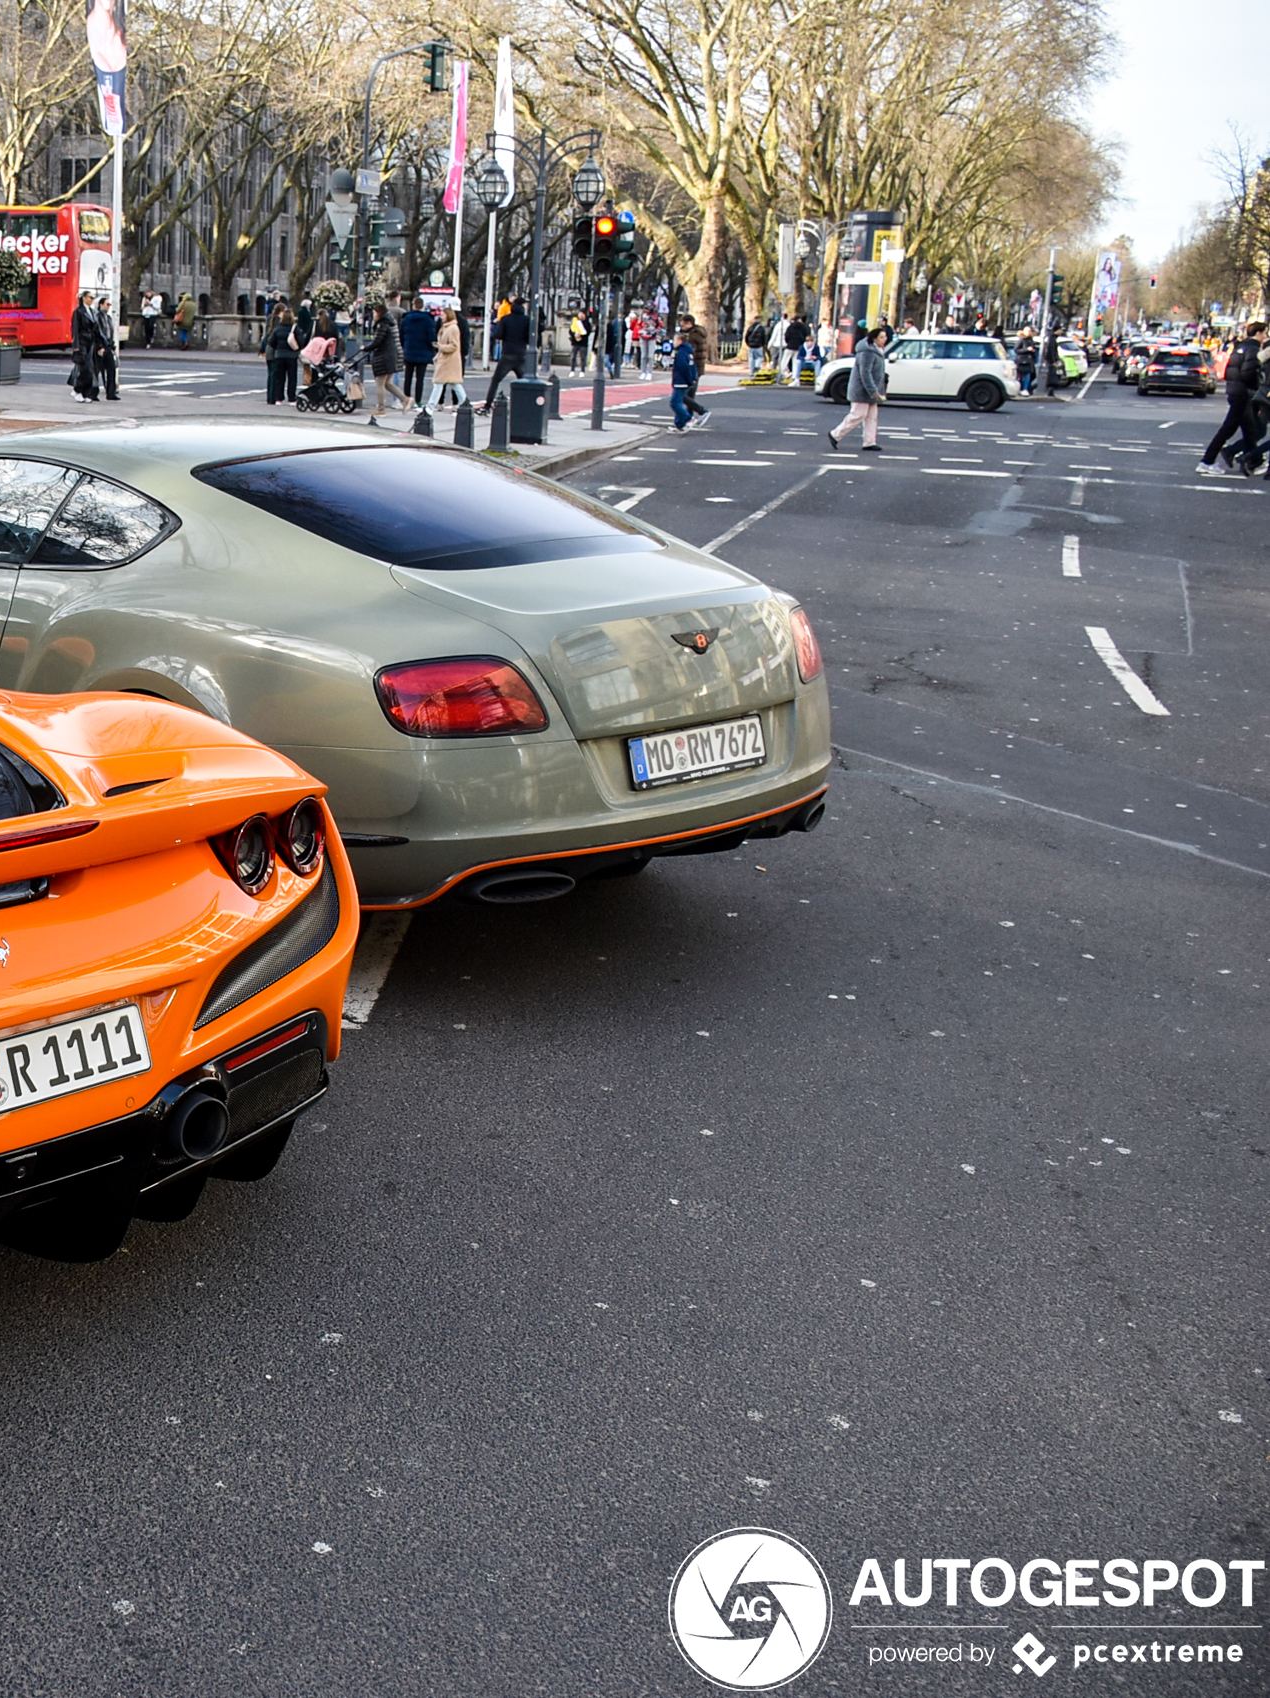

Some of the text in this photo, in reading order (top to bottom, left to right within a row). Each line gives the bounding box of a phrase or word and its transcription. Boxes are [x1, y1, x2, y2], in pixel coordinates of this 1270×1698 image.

[637, 722, 761, 774] D MO RM 7672
[6, 1043, 37, 1097] R
[42, 1015, 142, 1087] 1111
